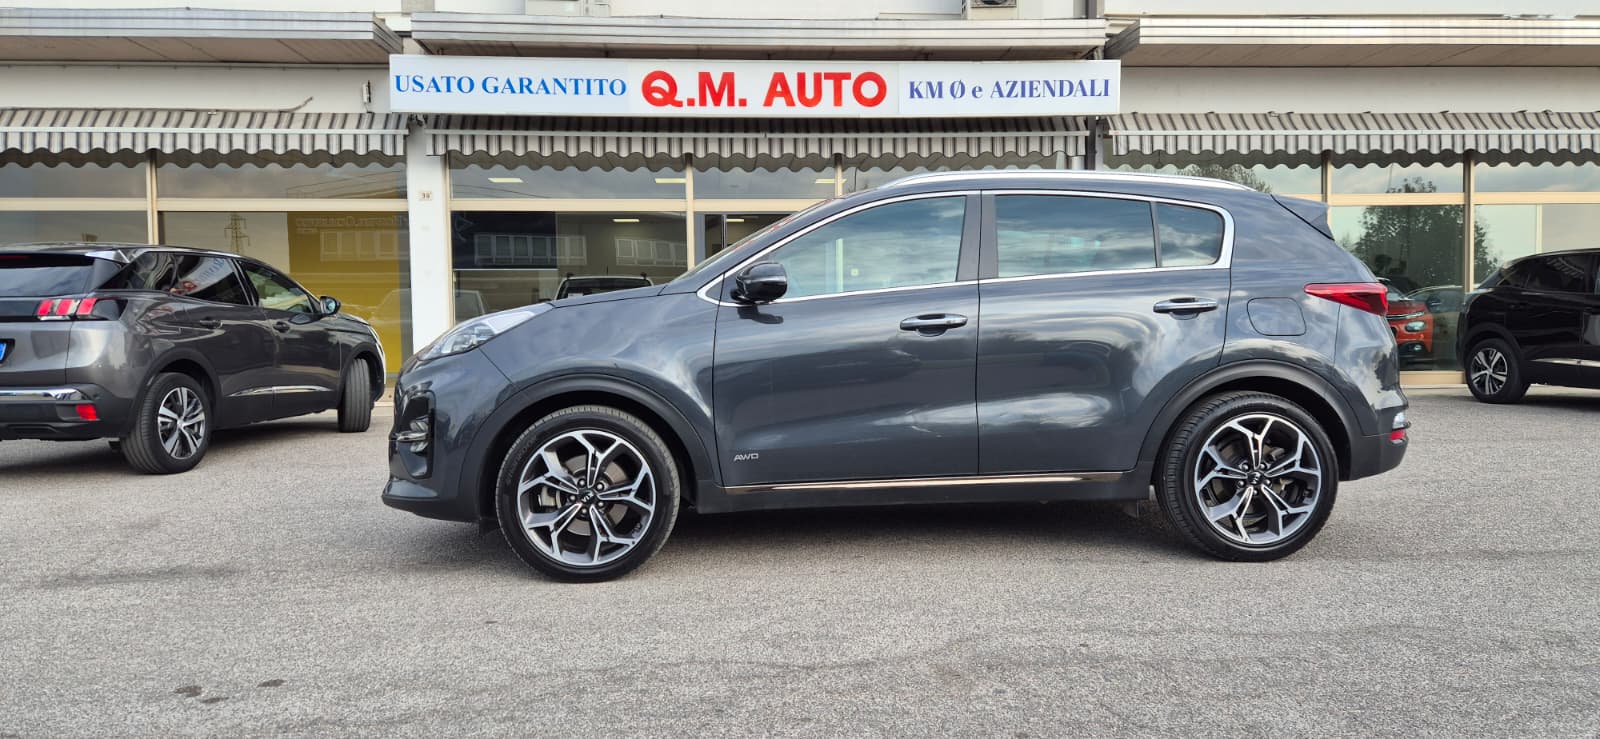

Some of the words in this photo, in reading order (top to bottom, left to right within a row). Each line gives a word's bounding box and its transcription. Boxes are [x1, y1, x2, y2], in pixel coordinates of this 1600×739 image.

[394, 74, 476, 94] USATO
[481, 75, 628, 97] GARANTITO
[641, 70, 748, 109] Q.M.
[762, 70, 887, 108] AUTO
[909, 80, 944, 99] KM
[972, 85, 983, 99] e
[990, 79, 1110, 98] AZIENDALI
[733, 452, 760, 462] AWD
